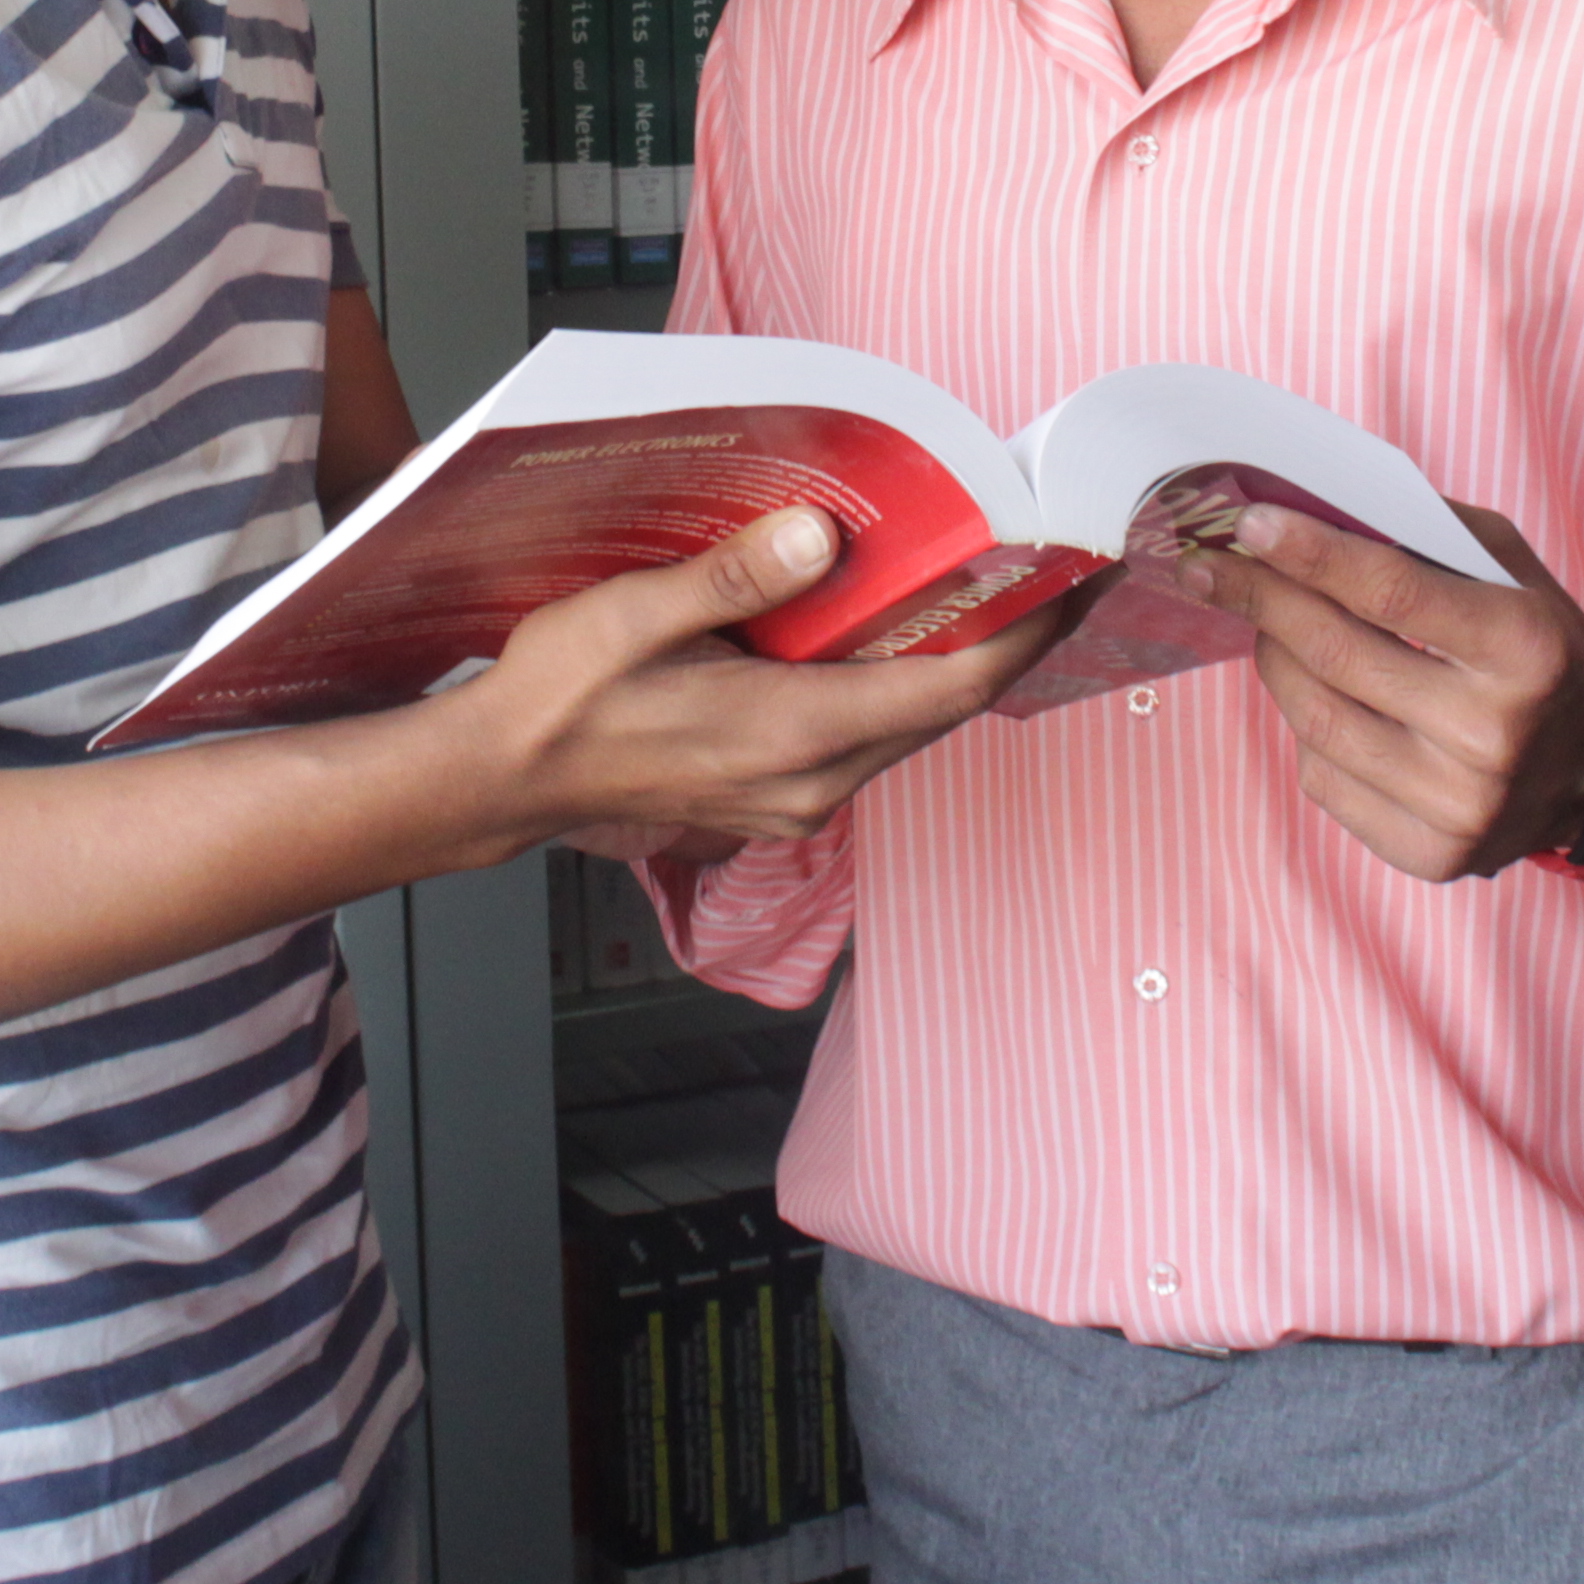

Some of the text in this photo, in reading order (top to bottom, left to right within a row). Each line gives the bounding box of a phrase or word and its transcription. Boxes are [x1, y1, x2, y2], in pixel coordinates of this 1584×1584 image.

[573, 59, 588, 90] and
[633, 57, 648, 88] and
[510, 432, 744, 468] POWER ELECTRONICS
[937, 564, 1037, 610] POWER
